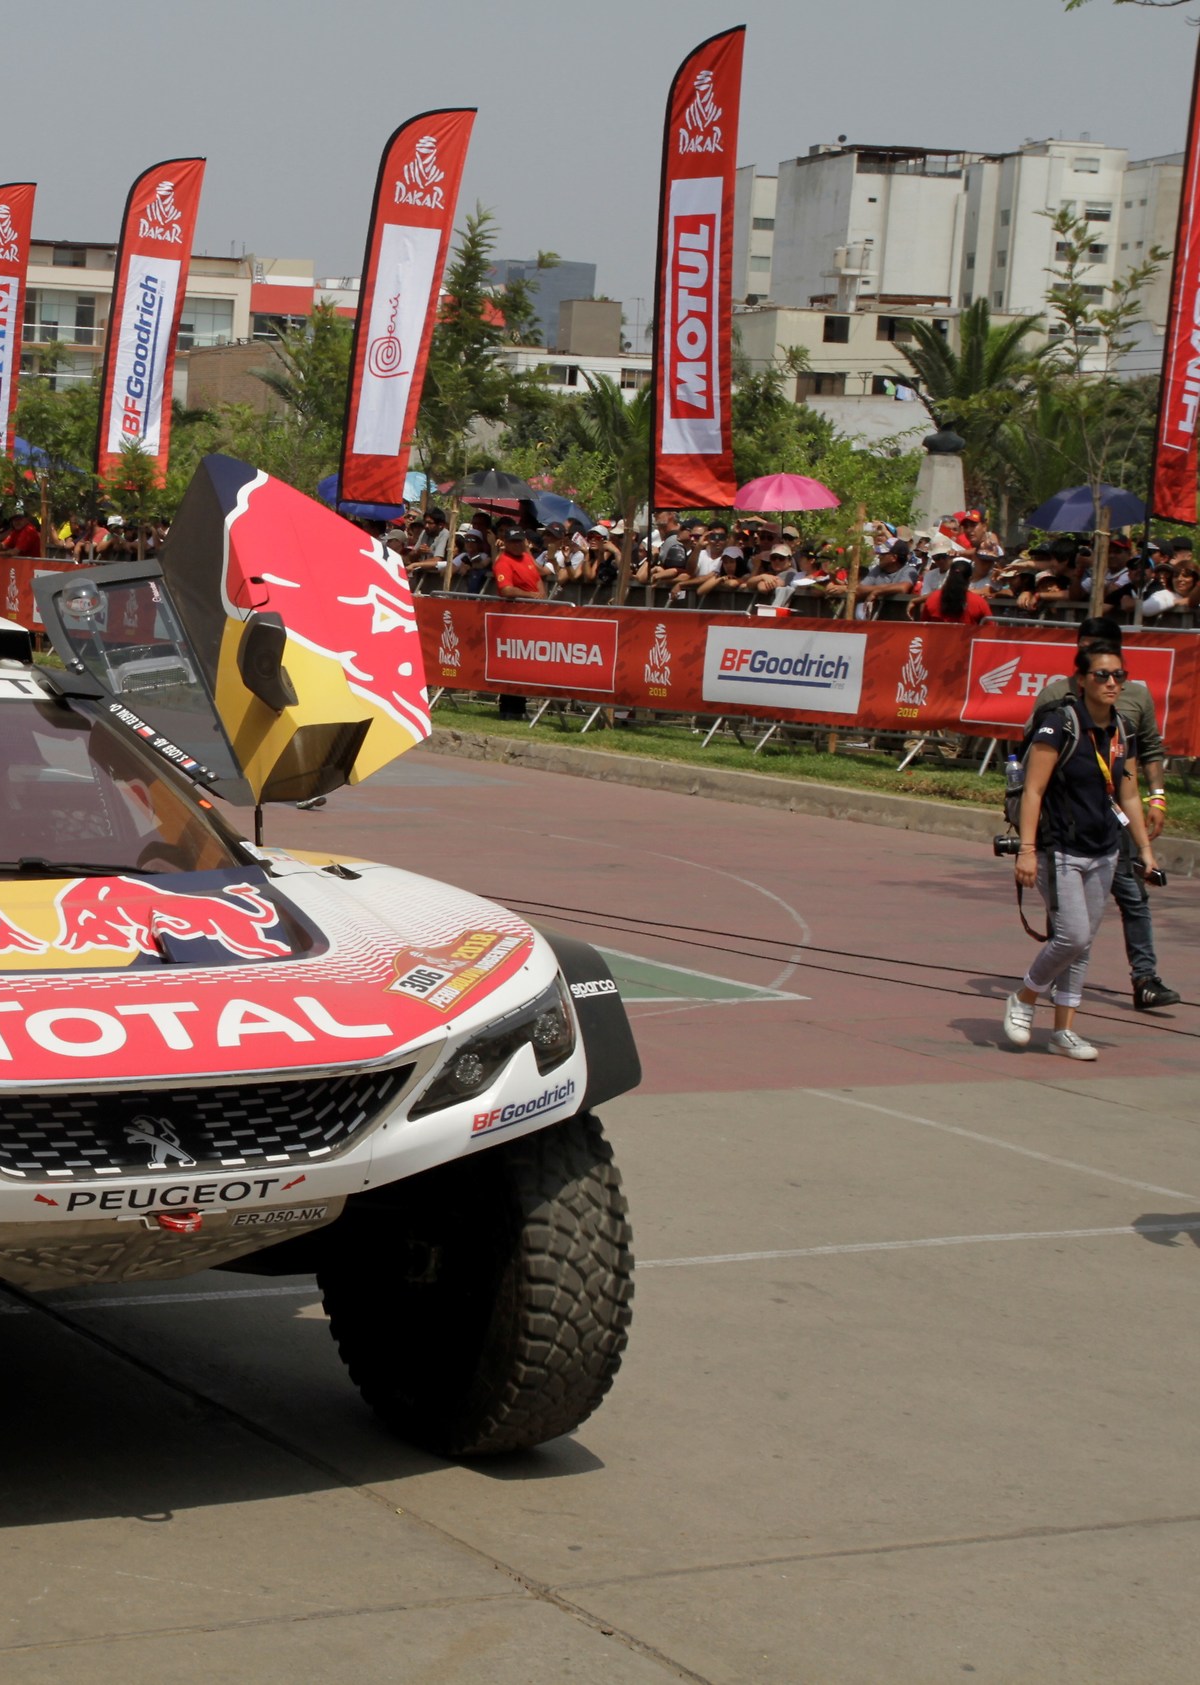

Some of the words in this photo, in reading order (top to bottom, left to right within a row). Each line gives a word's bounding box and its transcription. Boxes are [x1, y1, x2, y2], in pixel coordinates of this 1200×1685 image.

[678, 127, 723, 154] DAKAR
[394, 181, 445, 210] DAKAR
[139, 218, 182, 243] DAKAR
[676, 223, 710, 410] MOTUL
[121, 275, 158, 436] BFGoodrich
[439, 647, 461, 667] DAKAR
[496, 638, 603, 666] HIMOINSA
[720, 648, 849, 679] BFGoodrich
[442, 667, 457, 677] 2018
[644, 664, 672, 686] DAKAR
[649, 687, 667, 697] 2018
[896, 682, 927, 706] DAKAR
[897, 707, 918, 718] 2018
[451, 933, 498, 960] 2018
[400, 969, 444, 993] 306
[570, 978, 615, 997] sparco
[472, 1078, 575, 1132] BFGoodrich
[66, 1178, 280, 1212] PEUGEOT
[233, 1208, 325, 1227] ER-050-NK
